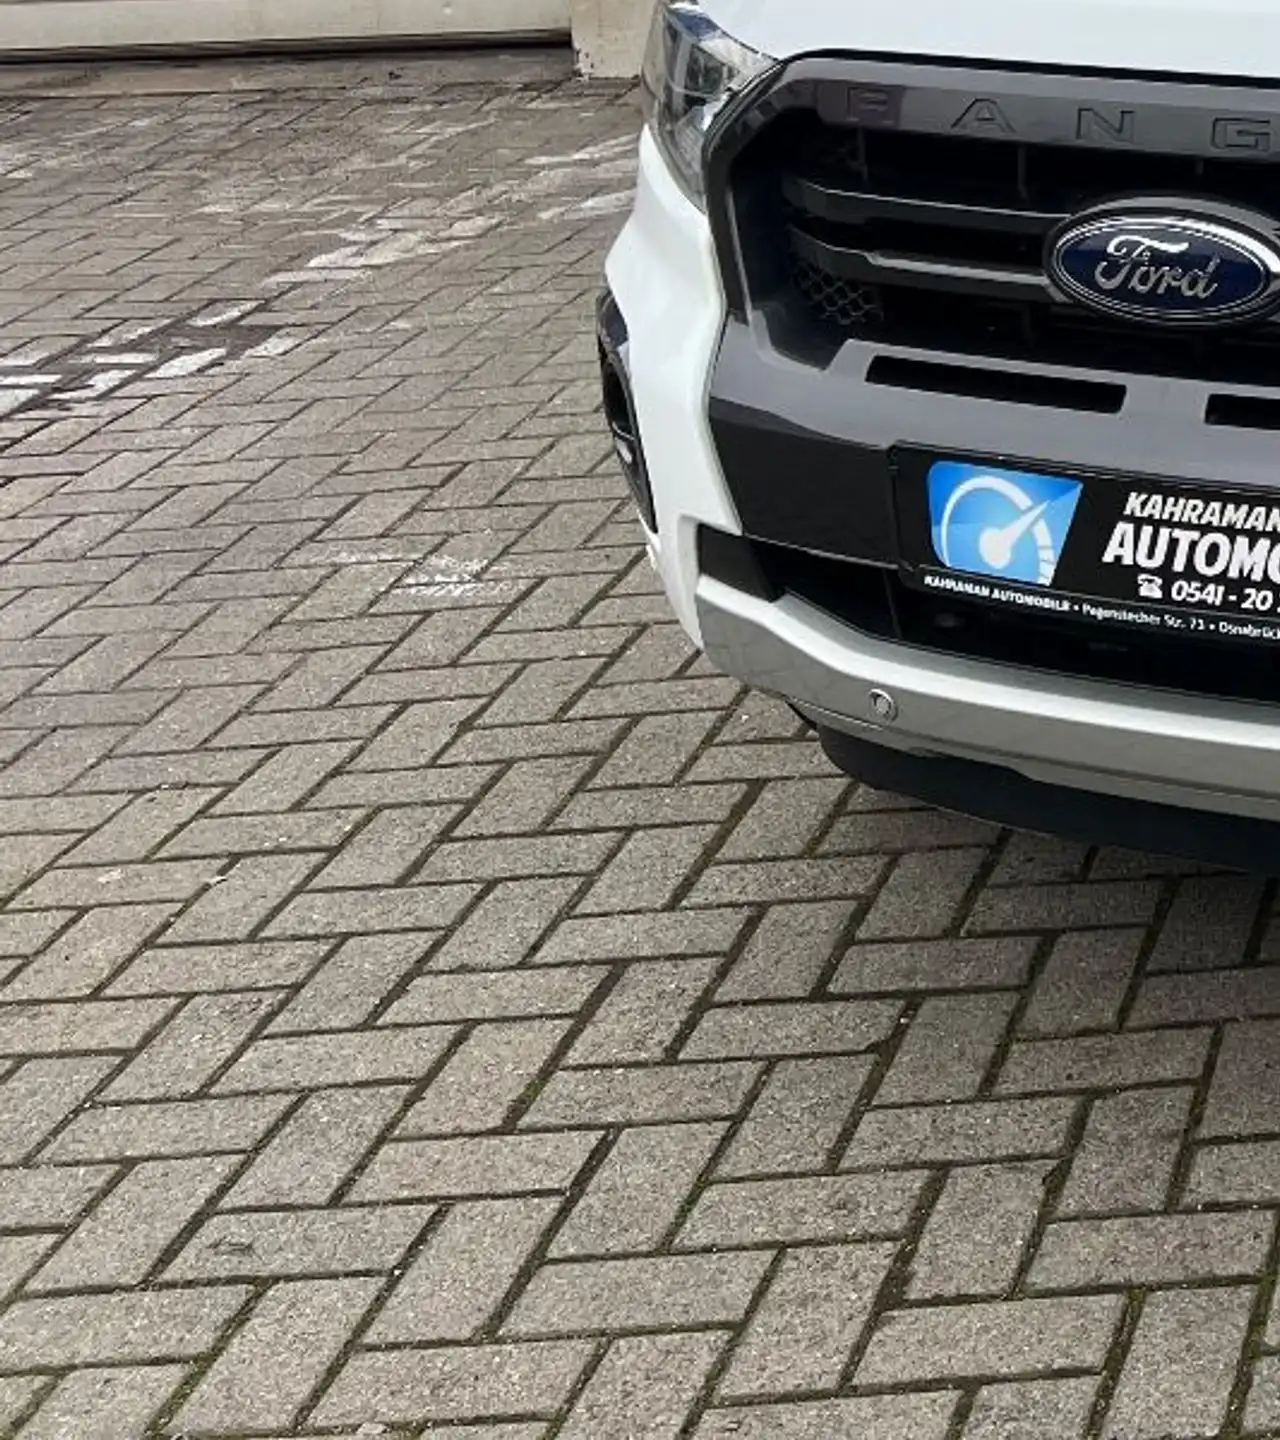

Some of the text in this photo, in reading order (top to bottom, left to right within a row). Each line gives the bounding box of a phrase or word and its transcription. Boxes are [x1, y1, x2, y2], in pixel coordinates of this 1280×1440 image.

[1095, 235, 1221, 299] Ford
[924, 574, 991, 598] KAHRAMAN
[991, 588, 1072, 613] AUTOMOBILE
[1170, 579, 1226, 607] 0541
[1240, 587, 1274, 612] 20
